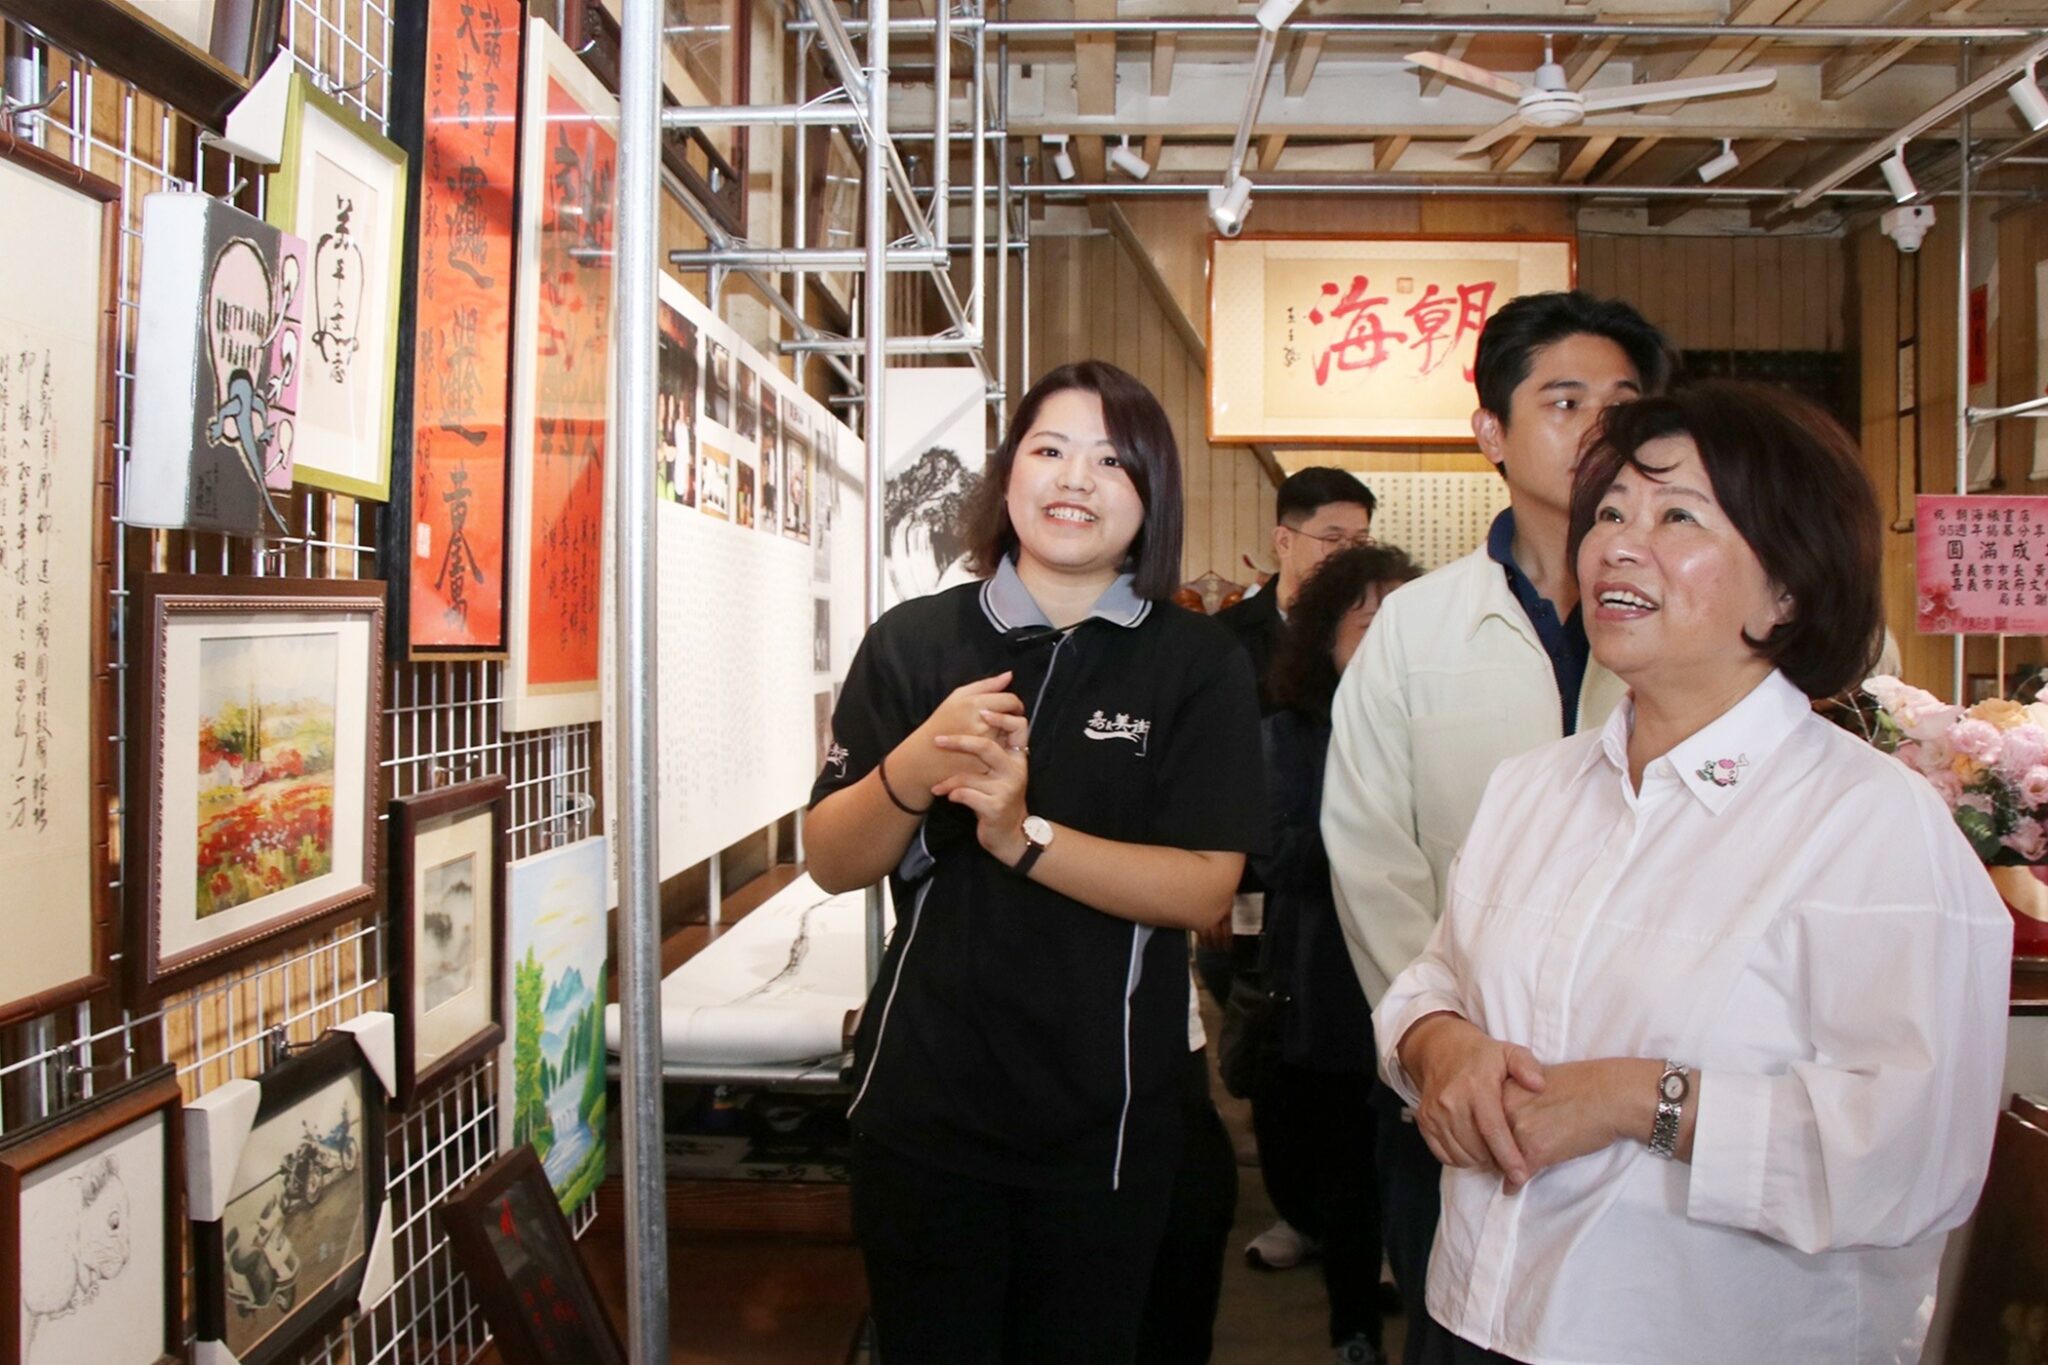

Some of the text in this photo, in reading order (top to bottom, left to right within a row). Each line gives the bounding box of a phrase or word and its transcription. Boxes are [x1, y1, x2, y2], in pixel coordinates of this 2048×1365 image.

[1947, 539, 2048, 561] 圓滿成
[1951, 563, 2025, 578] 嘉義市市長
